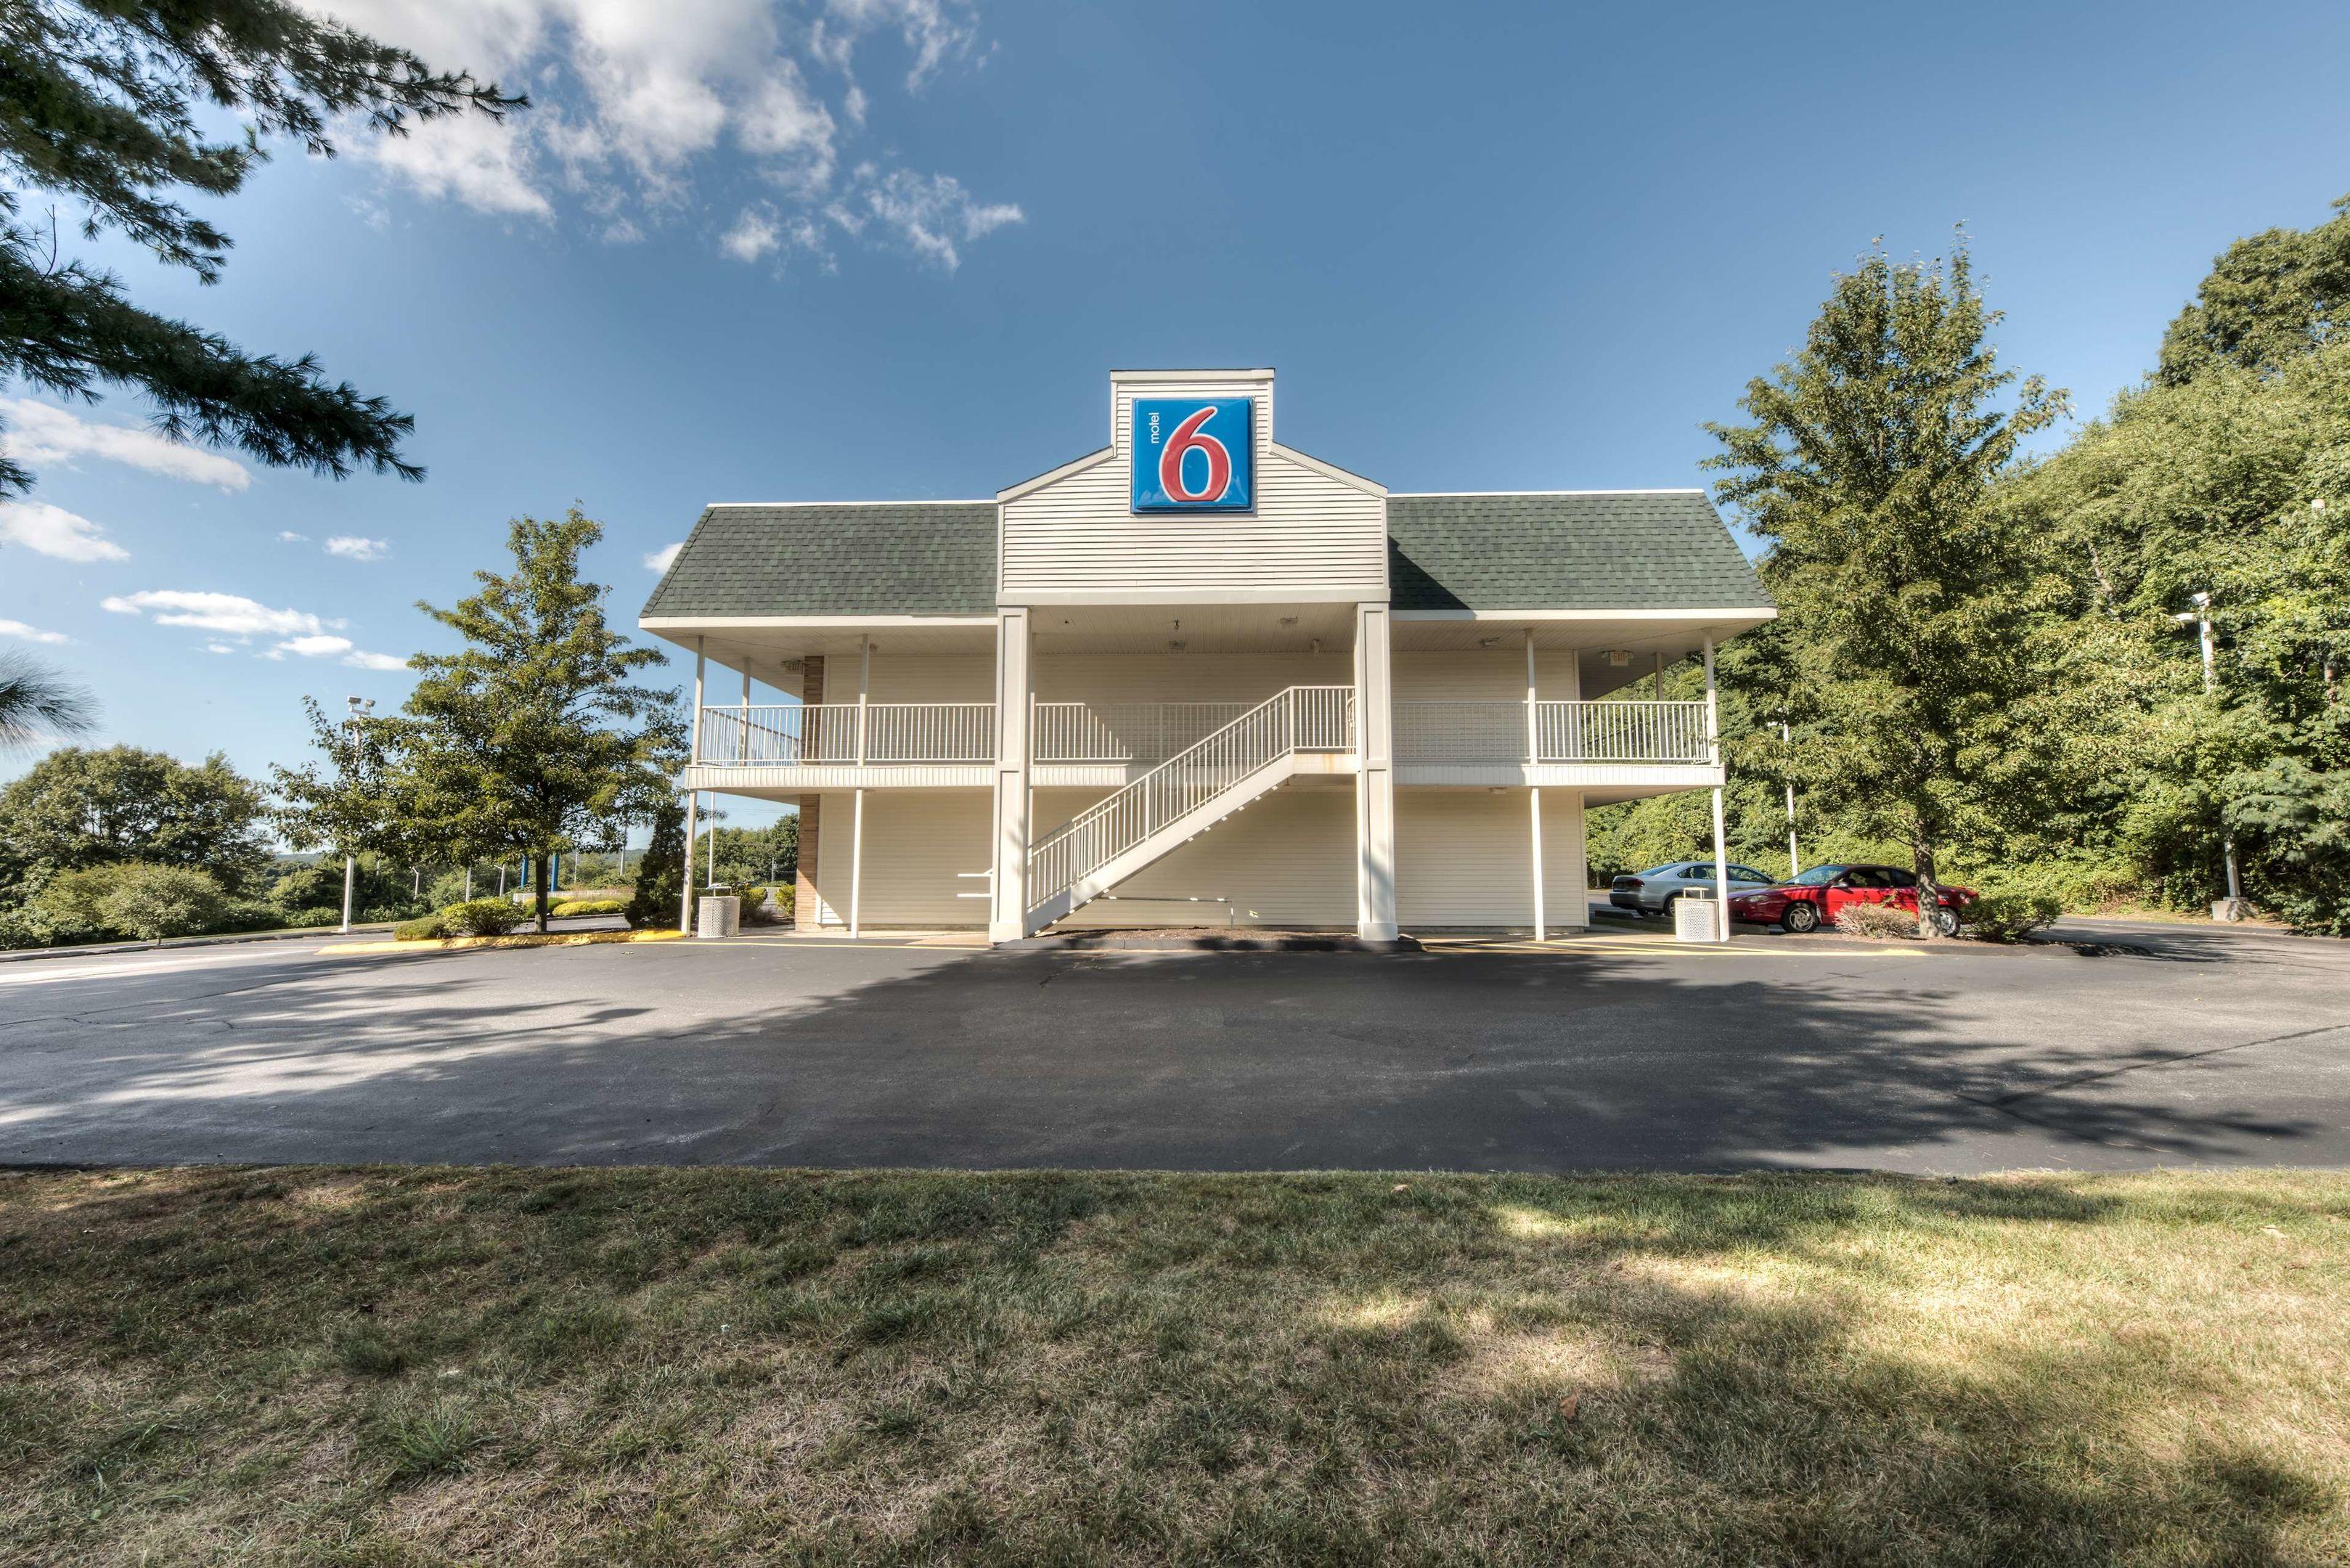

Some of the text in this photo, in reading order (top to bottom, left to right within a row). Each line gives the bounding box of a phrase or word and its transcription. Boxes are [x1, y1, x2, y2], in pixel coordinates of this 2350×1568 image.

[1149, 412, 1159, 444] motel
[1159, 406, 1232, 502] 6
[1614, 653, 1625, 661] EXIT
